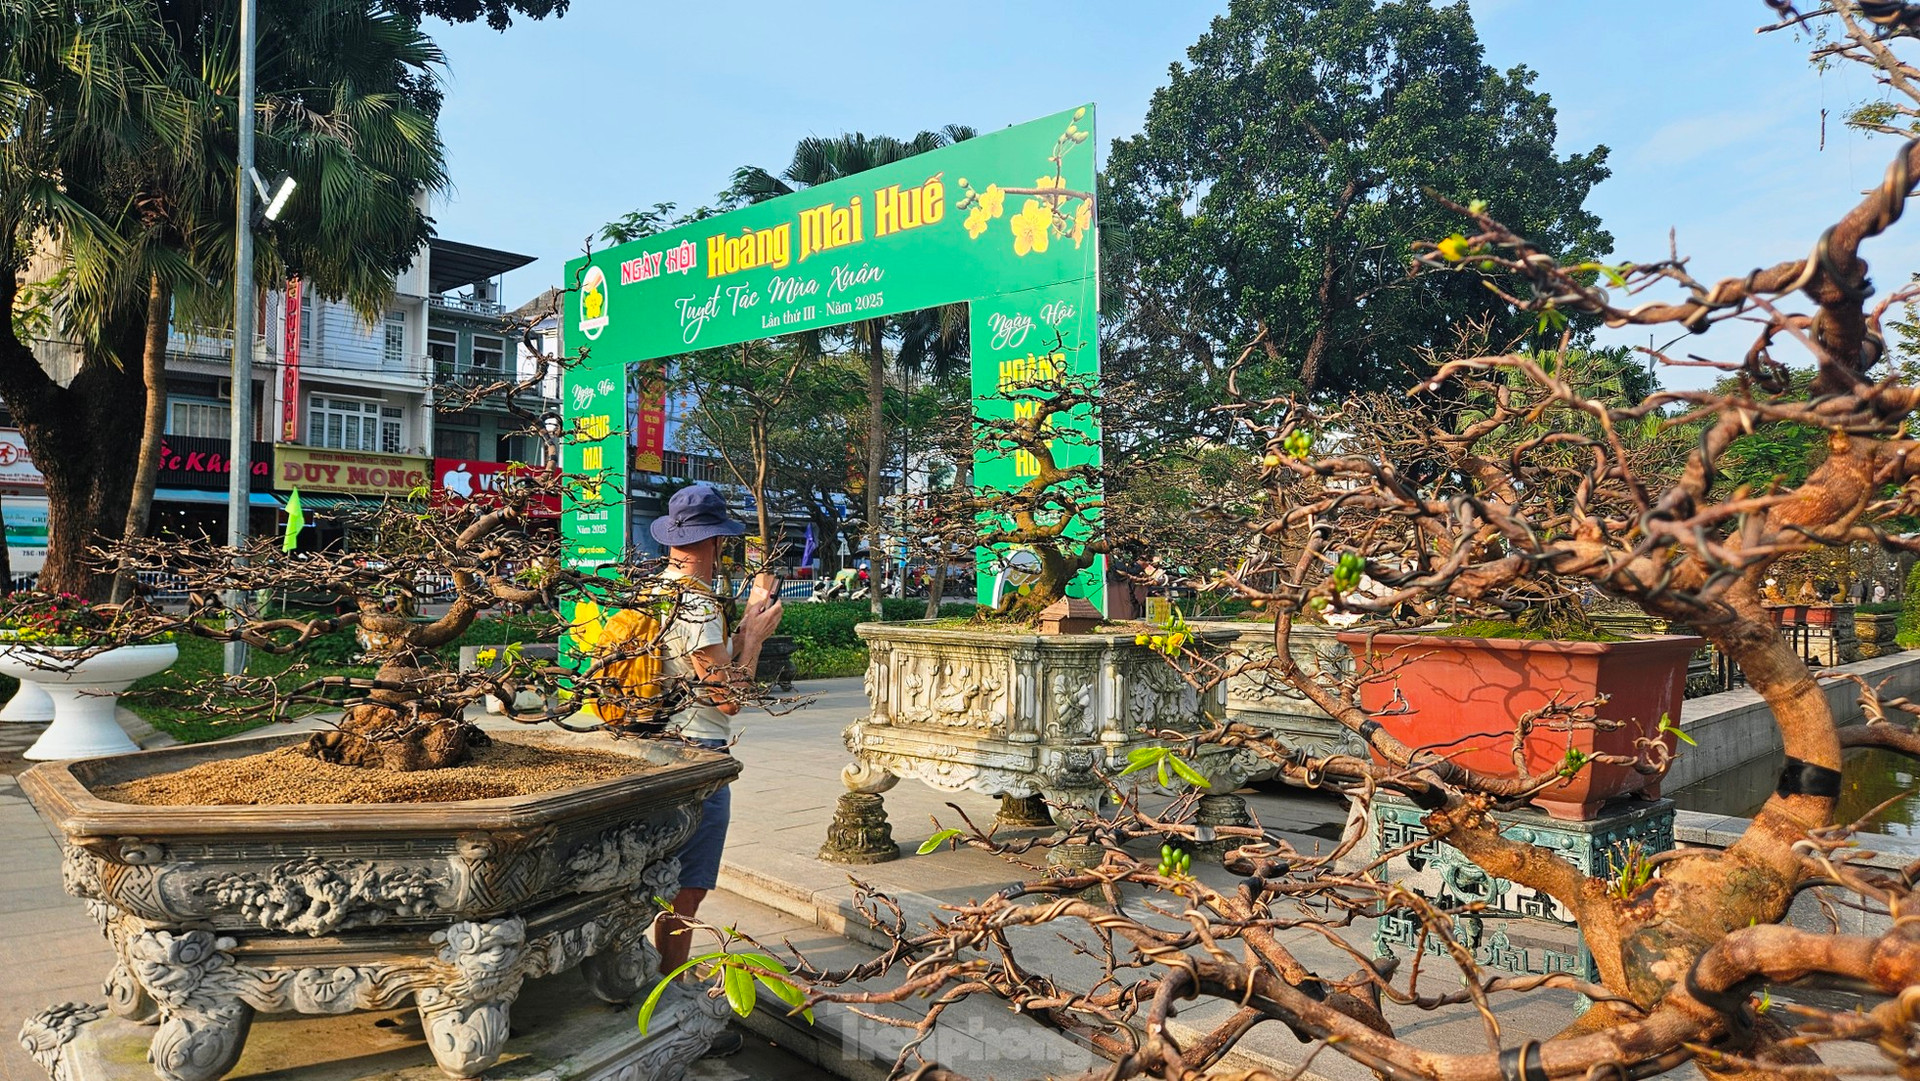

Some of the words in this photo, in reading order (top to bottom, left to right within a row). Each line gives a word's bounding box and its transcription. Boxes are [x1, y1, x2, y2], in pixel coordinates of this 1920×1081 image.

[620, 243, 662, 285] NGÀY
[666, 239, 697, 275] HỘI
[707, 226, 791, 279] Hoàng
[798, 195, 863, 263] Mai
[874, 171, 945, 238] Huế
[674, 285, 721, 344] Tuyệt
[726, 281, 760, 317] Tác
[767, 275, 820, 305] Mùa
[827, 262, 885, 297] Xuân
[761, 311, 781, 329] Lần
[782, 310, 802, 327] thứ
[803, 306, 816, 321] III
[826, 302, 853, 318] Năm
[854, 292, 884, 312] 2025
[988, 312, 1037, 350] Ngày
[1040, 301, 1077, 326] Hội
[571, 384, 597, 411] Ngày
[597, 378, 615, 396] Hội
[283, 461, 341, 484] DUY
[346, 466, 424, 489] MONG
[583, 446, 603, 470] MAI
[576, 524, 591, 535] Năm
[591, 523, 607, 534] 2025
